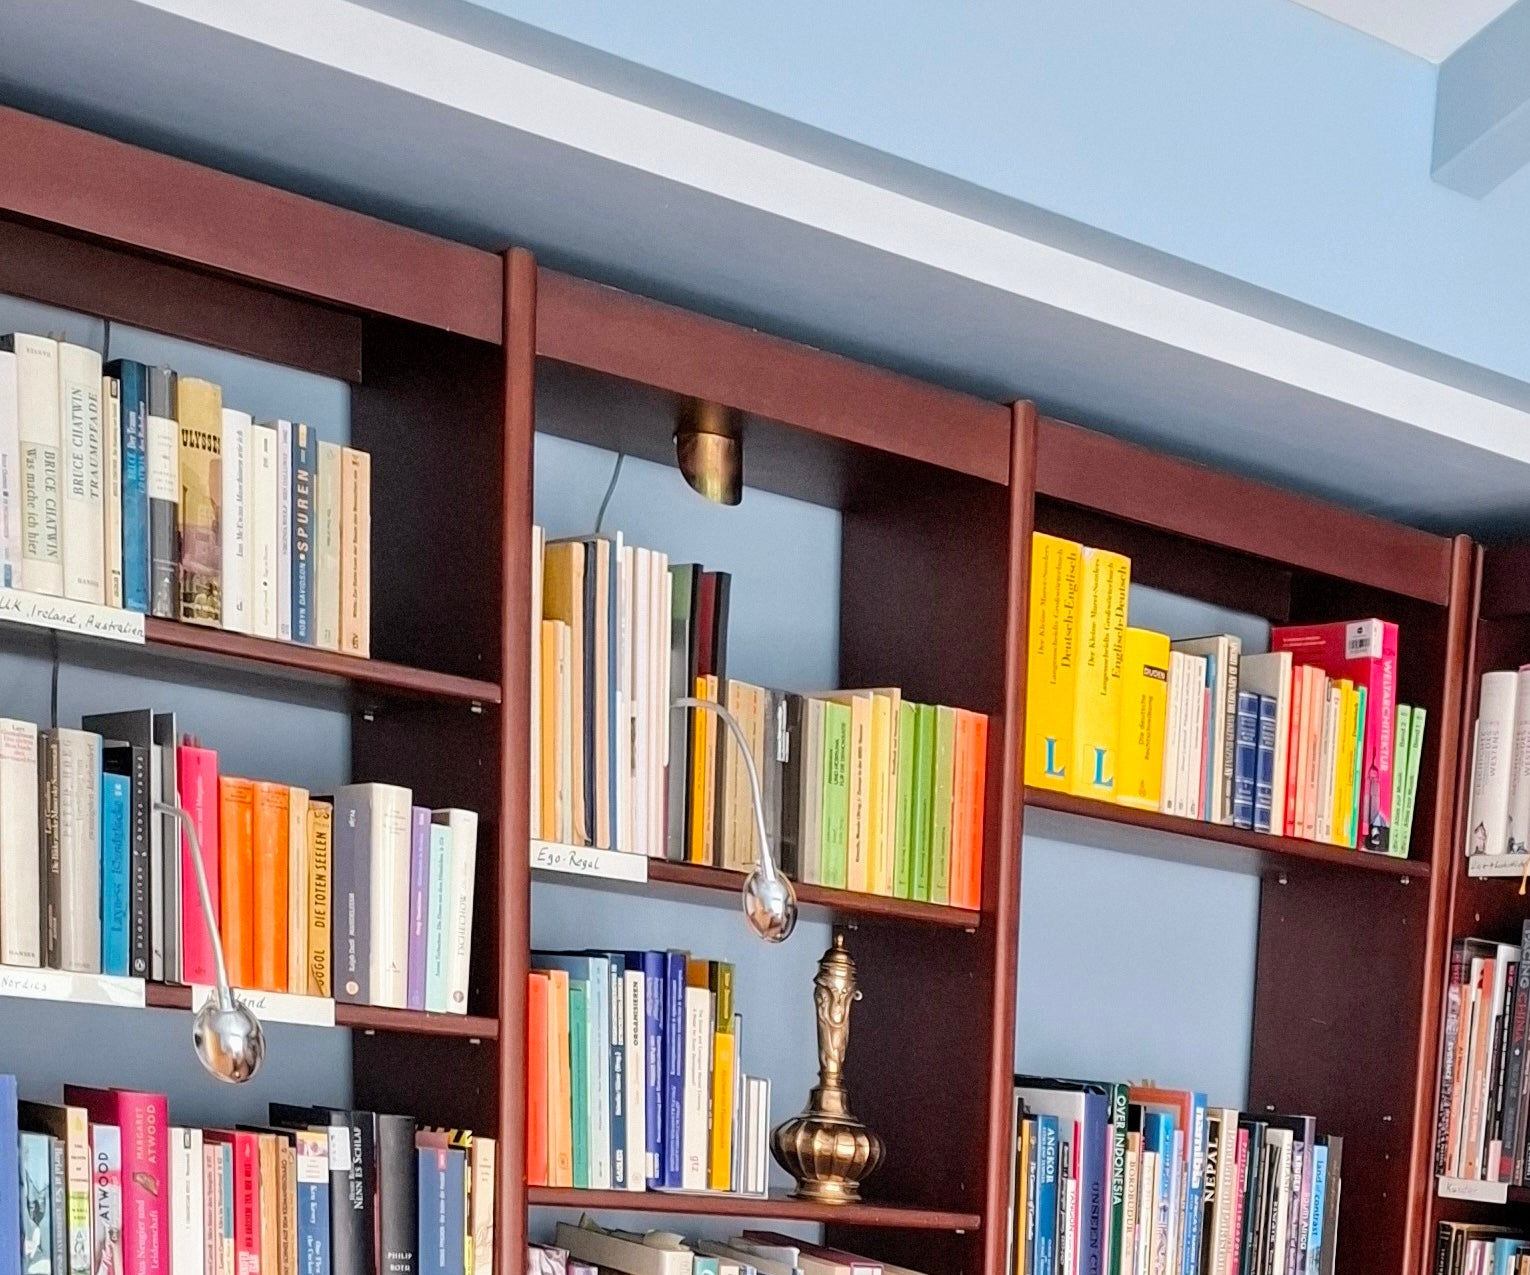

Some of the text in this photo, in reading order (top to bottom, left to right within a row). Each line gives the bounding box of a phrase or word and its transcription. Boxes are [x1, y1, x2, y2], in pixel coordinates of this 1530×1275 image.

[72, 388, 84, 496] BRUCE CHATWIN
[90, 393, 98, 498] TRAUMPFADE
[27, 471, 39, 555] mache ich hier
[44, 451, 57, 557] BRUCE CHATWIN
[296, 470, 309, 552] SPUREN
[1060, 552, 1077, 668] Deutsch-Englisch
[1111, 566, 1128, 679] Englisch-Deutsch
[1144, 666, 1165, 680] DUDEN
[1379, 660, 1392, 772] WELTARCHITEKTUR
[1045, 736, 1066, 777] L
[1093, 747, 1114, 787] L
[314, 831, 326, 928] DIE TOTEN SEELEN
[536, 845, 602, 871] Ego-Regal
[1513, 992, 1527, 1043] CHINA
[147, 1104, 157, 1164] ATWOOD
[1045, 1127, 1056, 1184] ANGKOR
[1112, 1095, 1127, 1206] OVER INDONESIA
[1204, 1137, 1219, 1202] NEPAL
[98, 1151, 110, 1222] ATWOOD
[387, 1252, 413, 1260] PHILIP
